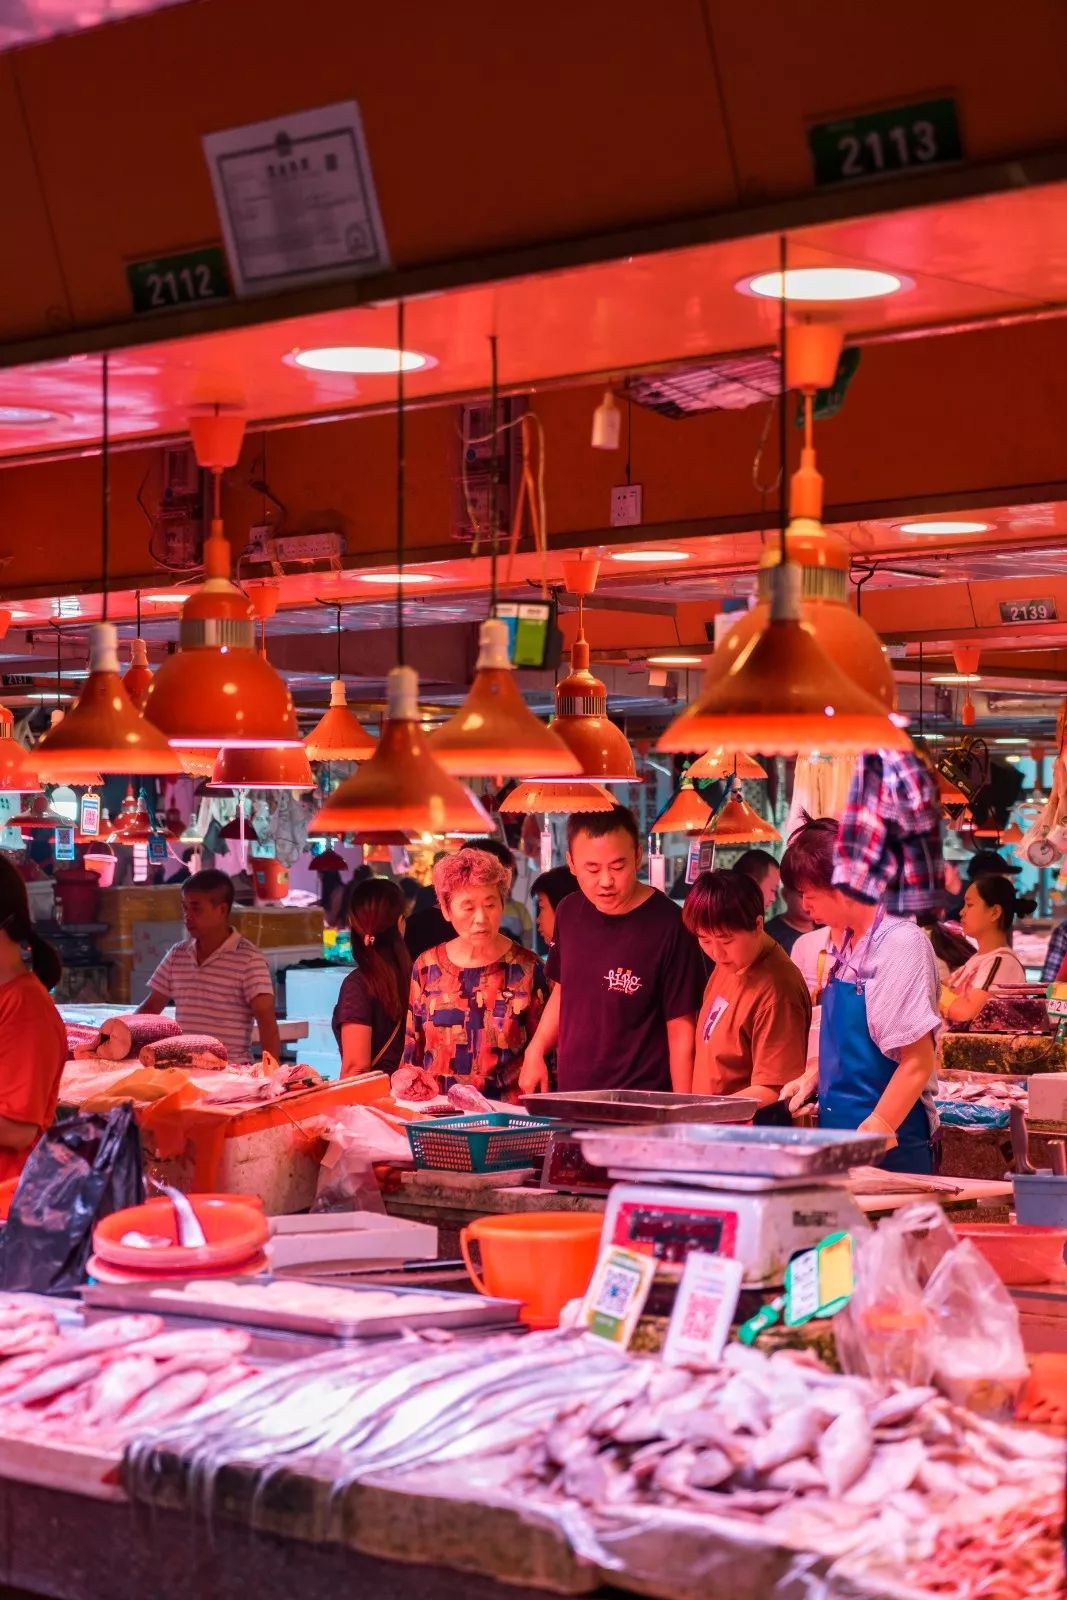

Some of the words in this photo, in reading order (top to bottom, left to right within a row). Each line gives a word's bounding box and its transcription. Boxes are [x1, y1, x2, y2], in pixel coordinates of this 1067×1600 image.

[839, 121, 937, 175] 2113
[147, 264, 214, 304] 2112
[1011, 606, 1047, 620] 2139
